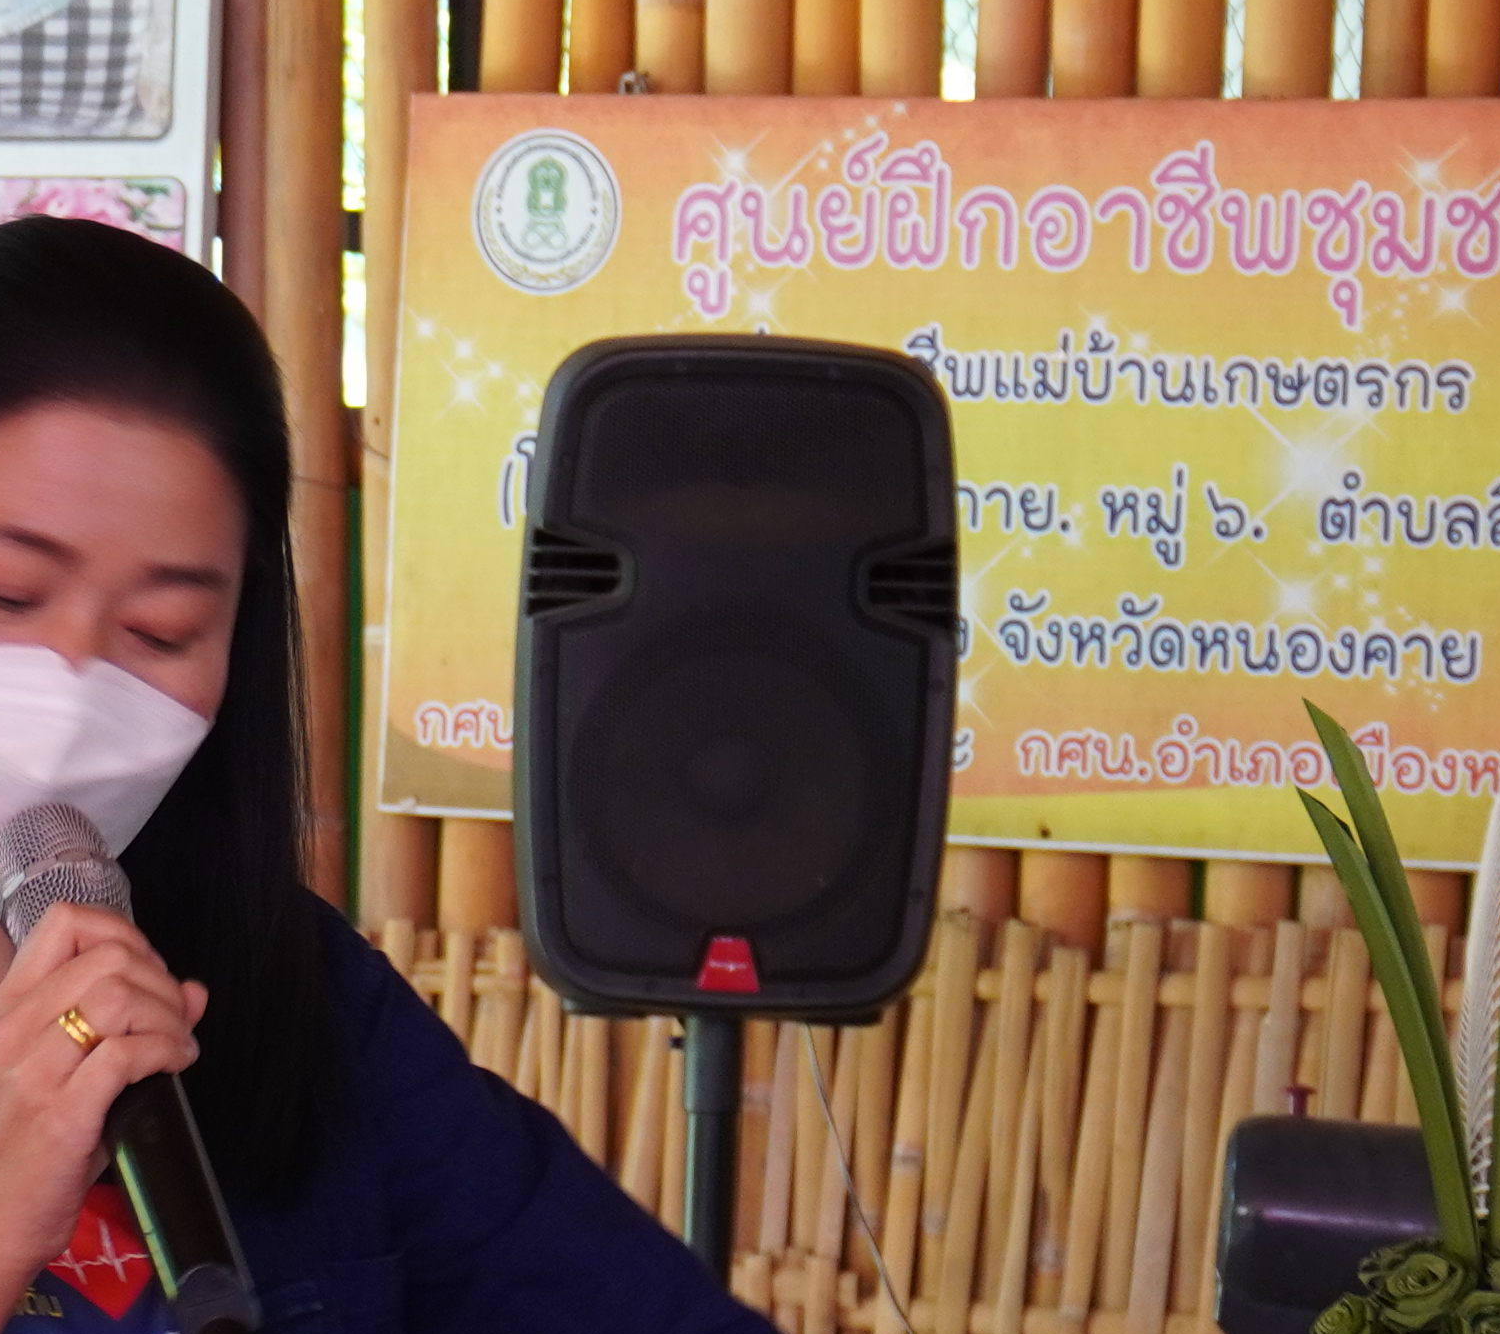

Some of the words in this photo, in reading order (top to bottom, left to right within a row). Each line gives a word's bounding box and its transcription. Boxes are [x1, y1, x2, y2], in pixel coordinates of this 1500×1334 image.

[1103, 468, 1184, 565] หมู่
[1000, 594, 1479, 680] จังหวัดหนองคาย
